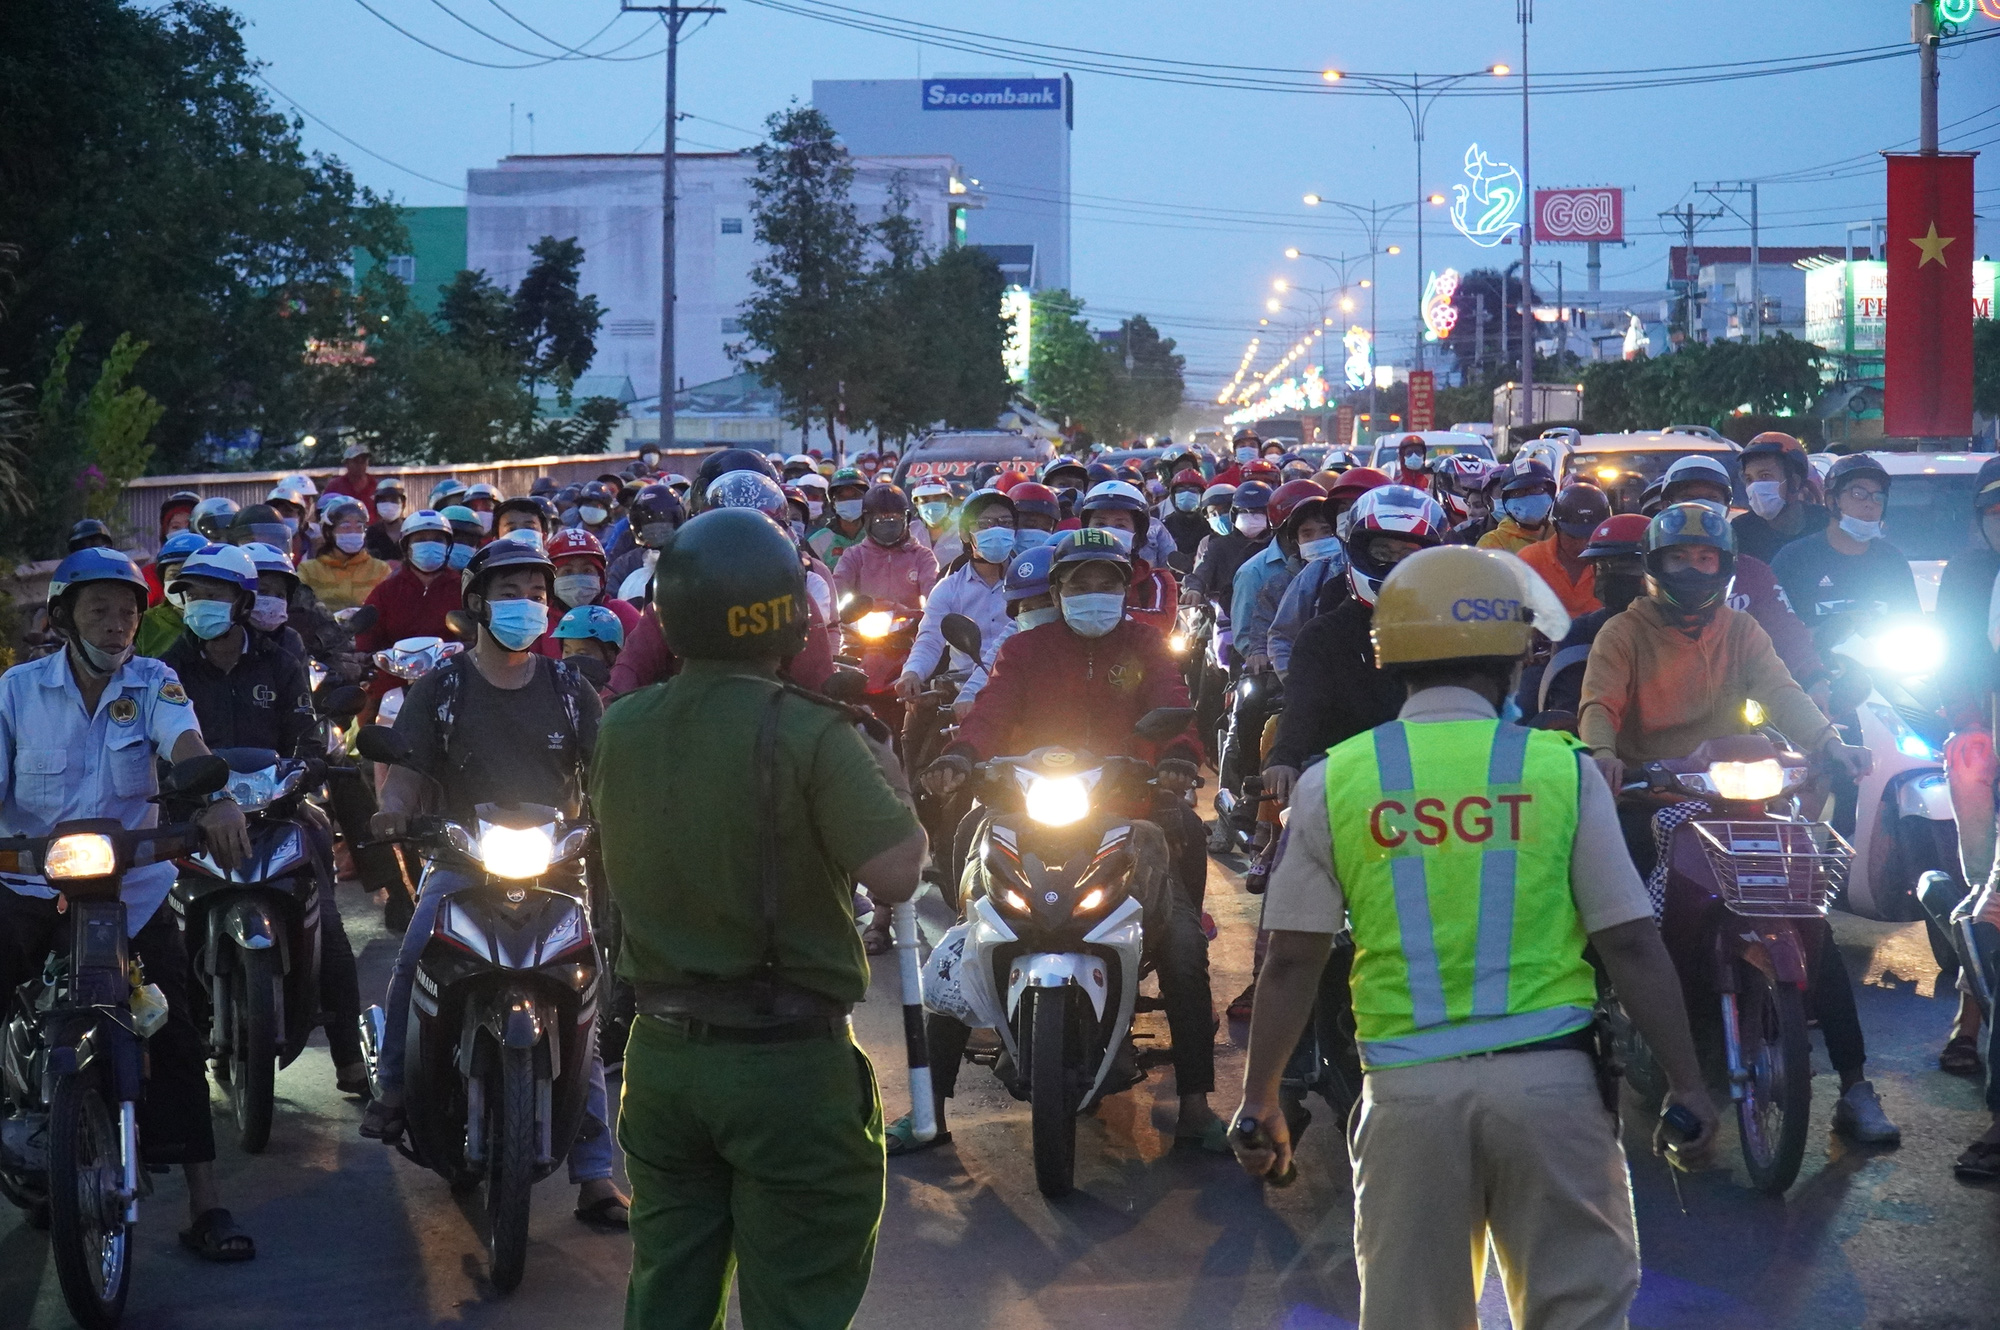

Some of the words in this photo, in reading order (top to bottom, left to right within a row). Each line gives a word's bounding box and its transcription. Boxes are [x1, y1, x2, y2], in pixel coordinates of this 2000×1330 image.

[927, 84, 1055, 105] Sacombank
[1543, 192, 1614, 237] GO!
[905, 461, 976, 477] DUY
[727, 594, 793, 637] CSTT
[1452, 598, 1521, 622] CSGT
[1370, 794, 1533, 848] CSGT
[416, 964, 438, 998] YAMAHA
